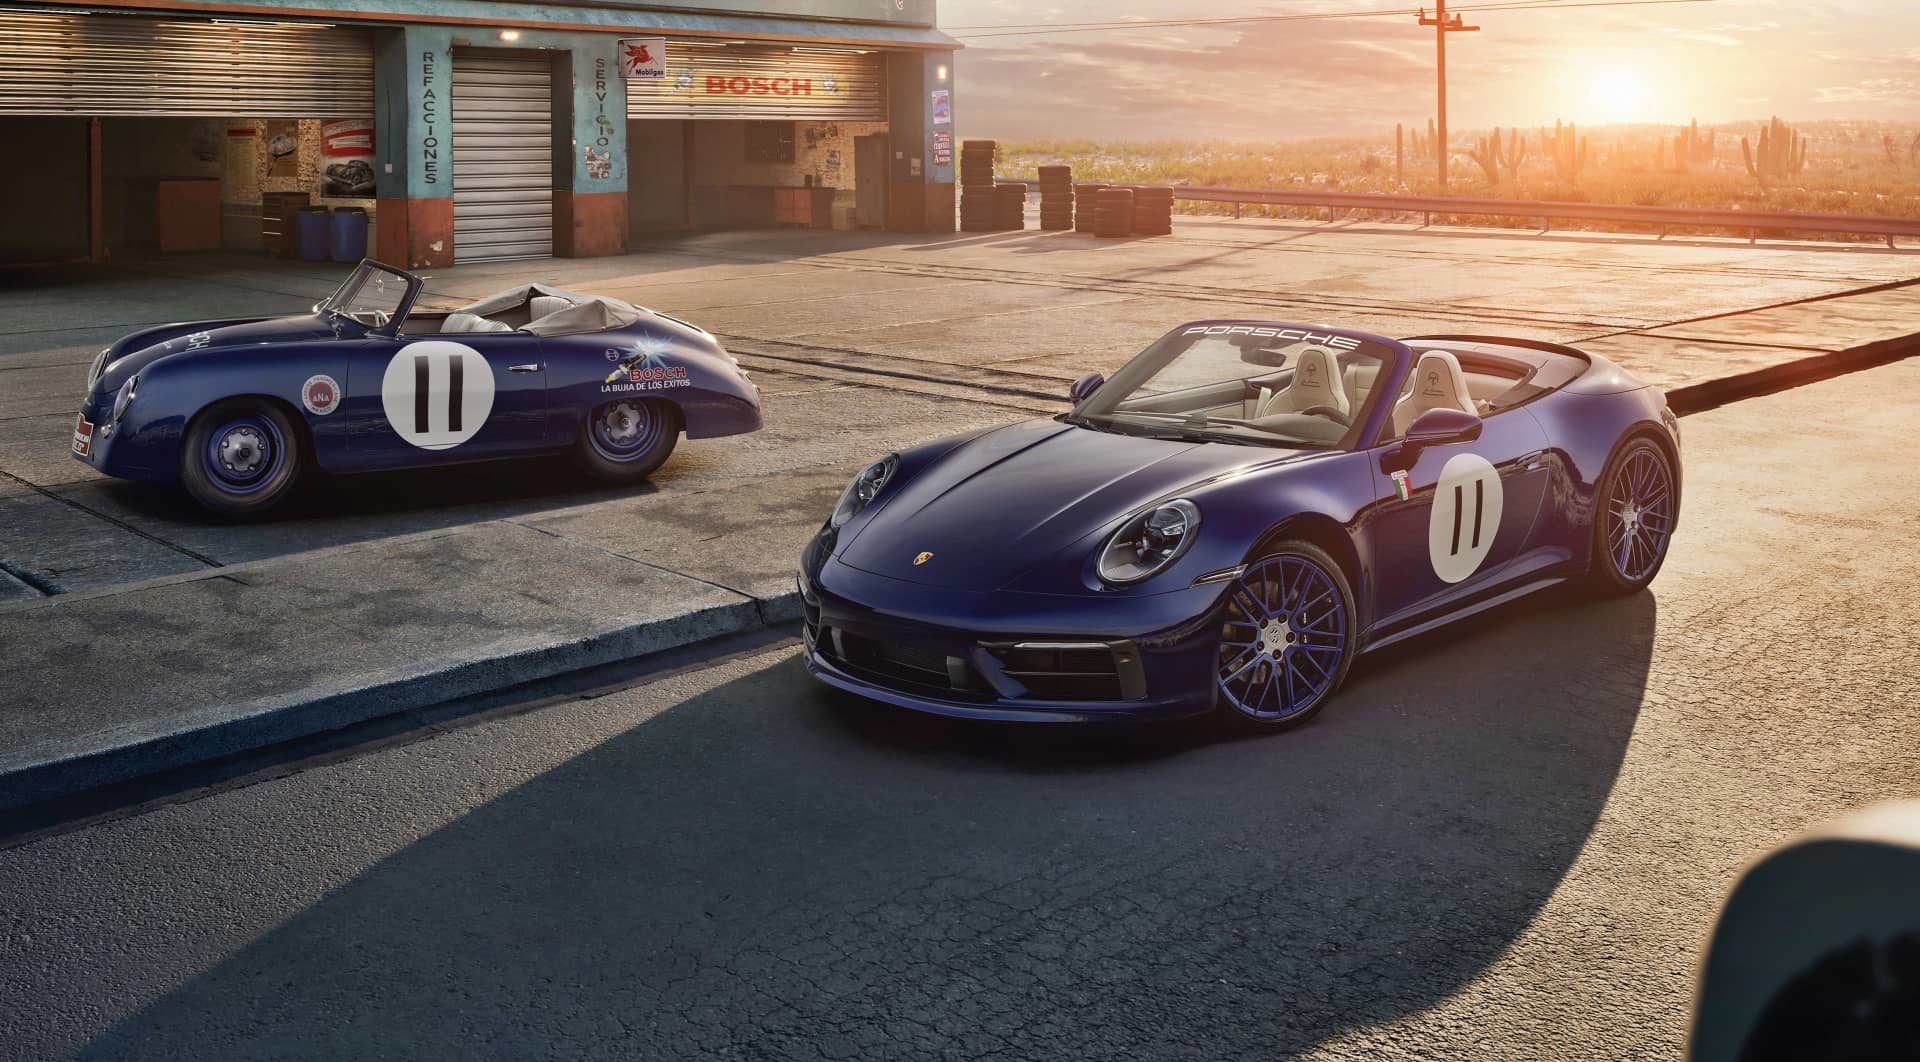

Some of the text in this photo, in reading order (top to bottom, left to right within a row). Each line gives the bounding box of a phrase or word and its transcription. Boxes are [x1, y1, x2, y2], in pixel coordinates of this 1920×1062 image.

[705, 75, 812, 96] BOSCH
[595, 58, 609, 147] SERVICIO
[423, 52, 438, 184] REFACCIONES
[1182, 326, 1362, 350] PORSCHE
[612, 383, 635, 392] BUJIA
[636, 382, 647, 391] DE
[648, 381, 662, 390] LOS
[663, 379, 691, 388] EXITOS
[630, 367, 686, 381] BOSCH
[313, 393, 329, 401] ANA
[414, 355, 463, 434] 11
[1450, 479, 1484, 556] 11
